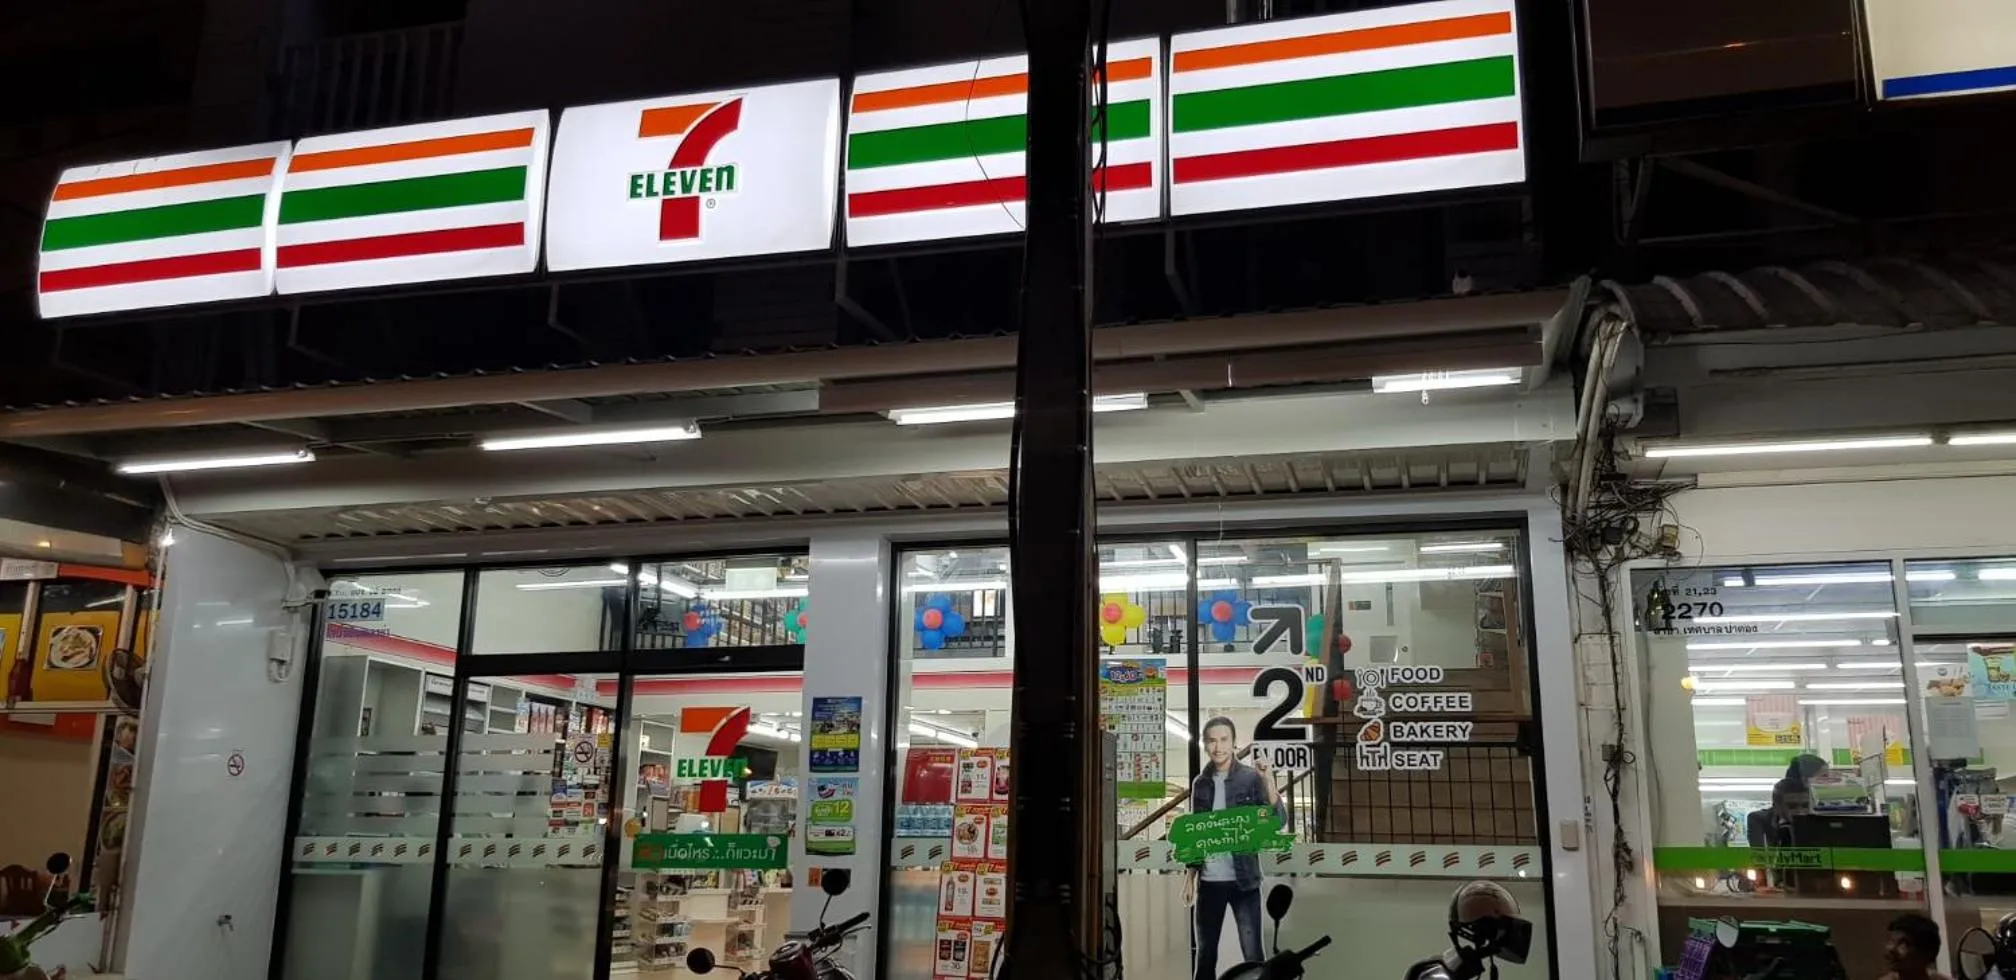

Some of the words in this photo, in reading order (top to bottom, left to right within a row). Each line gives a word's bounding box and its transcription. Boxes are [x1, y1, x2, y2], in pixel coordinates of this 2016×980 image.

[638, 97, 743, 241] 7
[327, 602, 382, 619] 15184
[1661, 601, 1724, 620] 2270
[1390, 667, 1441, 681] FOOD
[1253, 667, 1304, 741] 2
[1305, 666, 1325, 682] ND
[1391, 695, 1471, 709] COFFEE
[1392, 724, 1470, 739] BAKERY
[1393, 753, 1441, 767] SEAT
